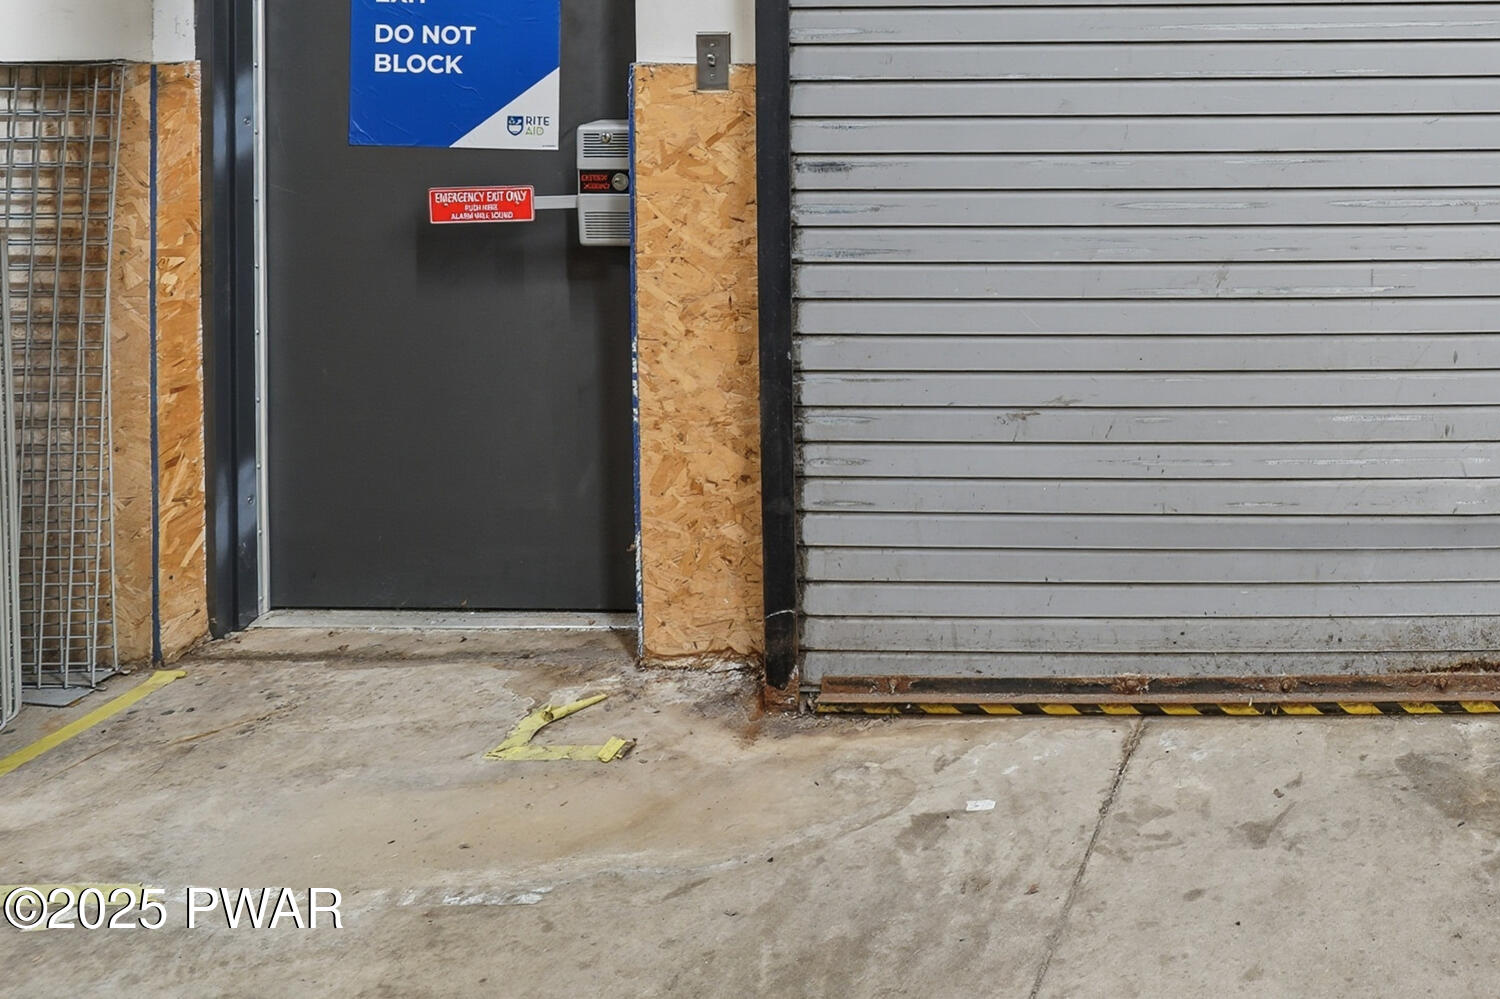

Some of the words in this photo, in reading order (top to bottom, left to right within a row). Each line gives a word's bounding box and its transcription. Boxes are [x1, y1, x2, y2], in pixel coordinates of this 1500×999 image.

[374, 24, 414, 44] DO
[422, 25, 476, 45] NOT
[374, 53, 463, 74] BLOCK
[525, 115, 551, 127] RITE
[525, 126, 545, 136] AID
[434, 191, 485, 204] EMERGENCY
[486, 191, 505, 202] EXIT
[506, 190, 528, 204] ONLY
